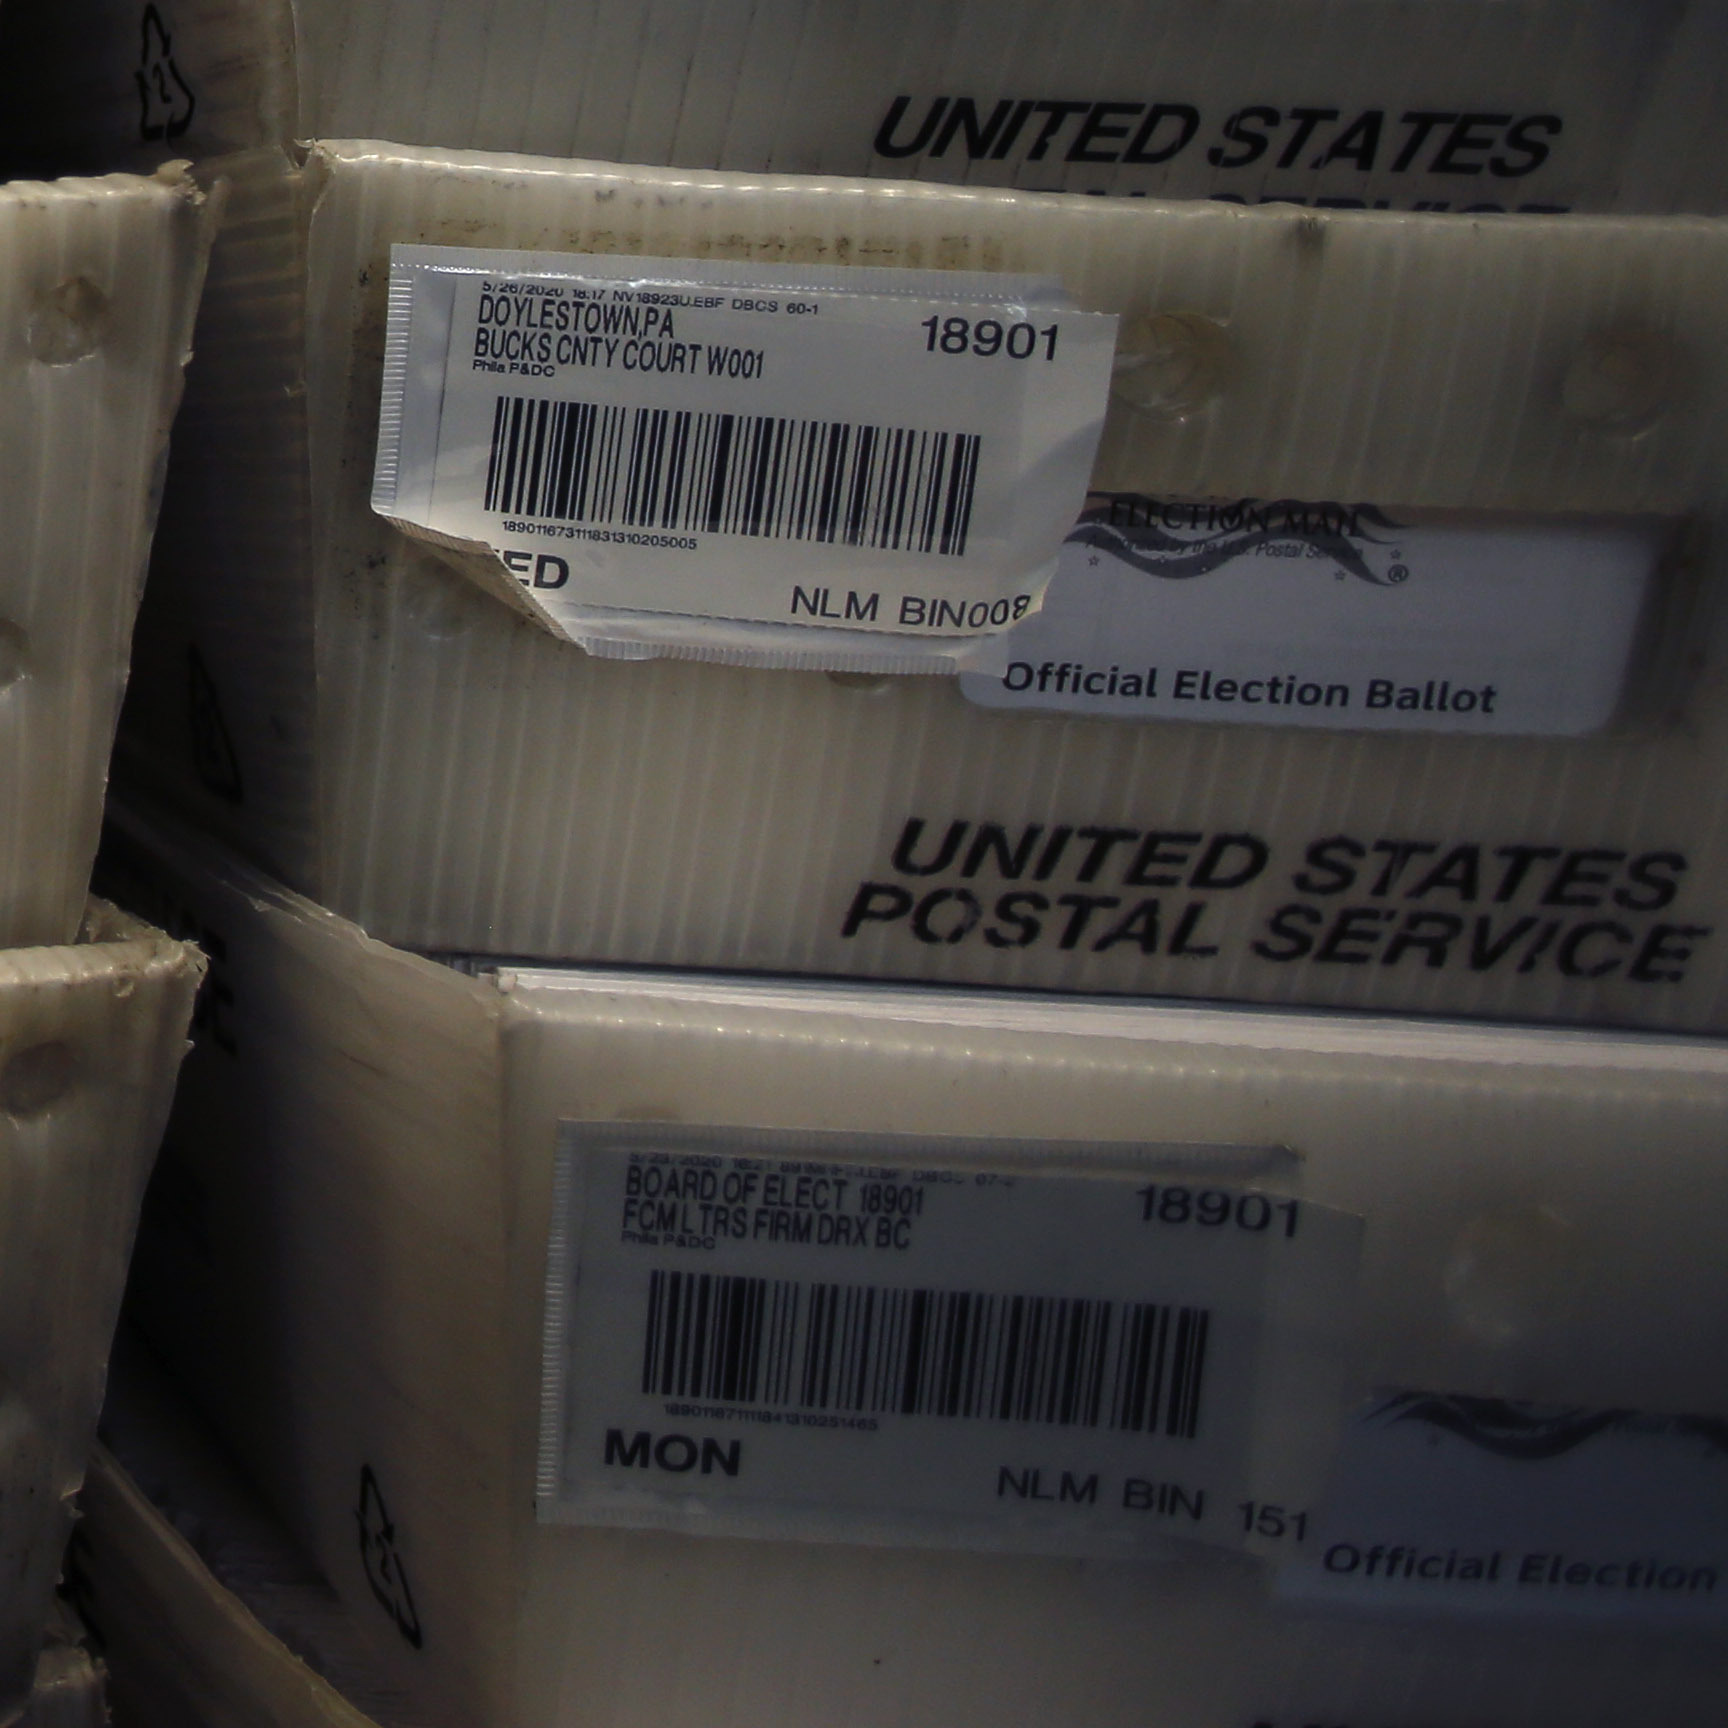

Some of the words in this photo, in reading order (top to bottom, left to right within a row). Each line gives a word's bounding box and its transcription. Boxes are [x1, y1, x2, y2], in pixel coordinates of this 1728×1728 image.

[873, 96, 1200, 163] UNITED
[1208, 105, 1563, 177] STATES
[478, 295, 674, 340] DOYLESTOWN,PA
[787, 302, 818, 315] 60-1
[475, 327, 551, 363] BUCKS
[557, 334, 618, 367] CNTY
[623, 341, 701, 373] COURT
[708, 347, 764, 378] W001
[920, 315, 1060, 363] 18901
[473, 360, 505, 373] Phila
[509, 362, 555, 377] P&DC
[790, 585, 879, 622] NLM
[1003, 661, 1157, 697] Official
[1173, 670, 1349, 707] Election
[1366, 678, 1497, 713] Ballot
[890, 821, 1266, 893] UNITED
[1290, 836, 1692, 911] STATES
[841, 883, 1220, 961] POSTAL
[1248, 906, 1715, 983] SERVICE
[1135, 1182, 1300, 1239] 18901
[605, 1428, 740, 1476] MON
[998, 1465, 1098, 1506] NLM
[1123, 1477, 1204, 1521] BIN
[1237, 1501, 1309, 1542] 151
[1323, 1544, 1501, 1582] Official
[1518, 1553, 1717, 1593] Election
